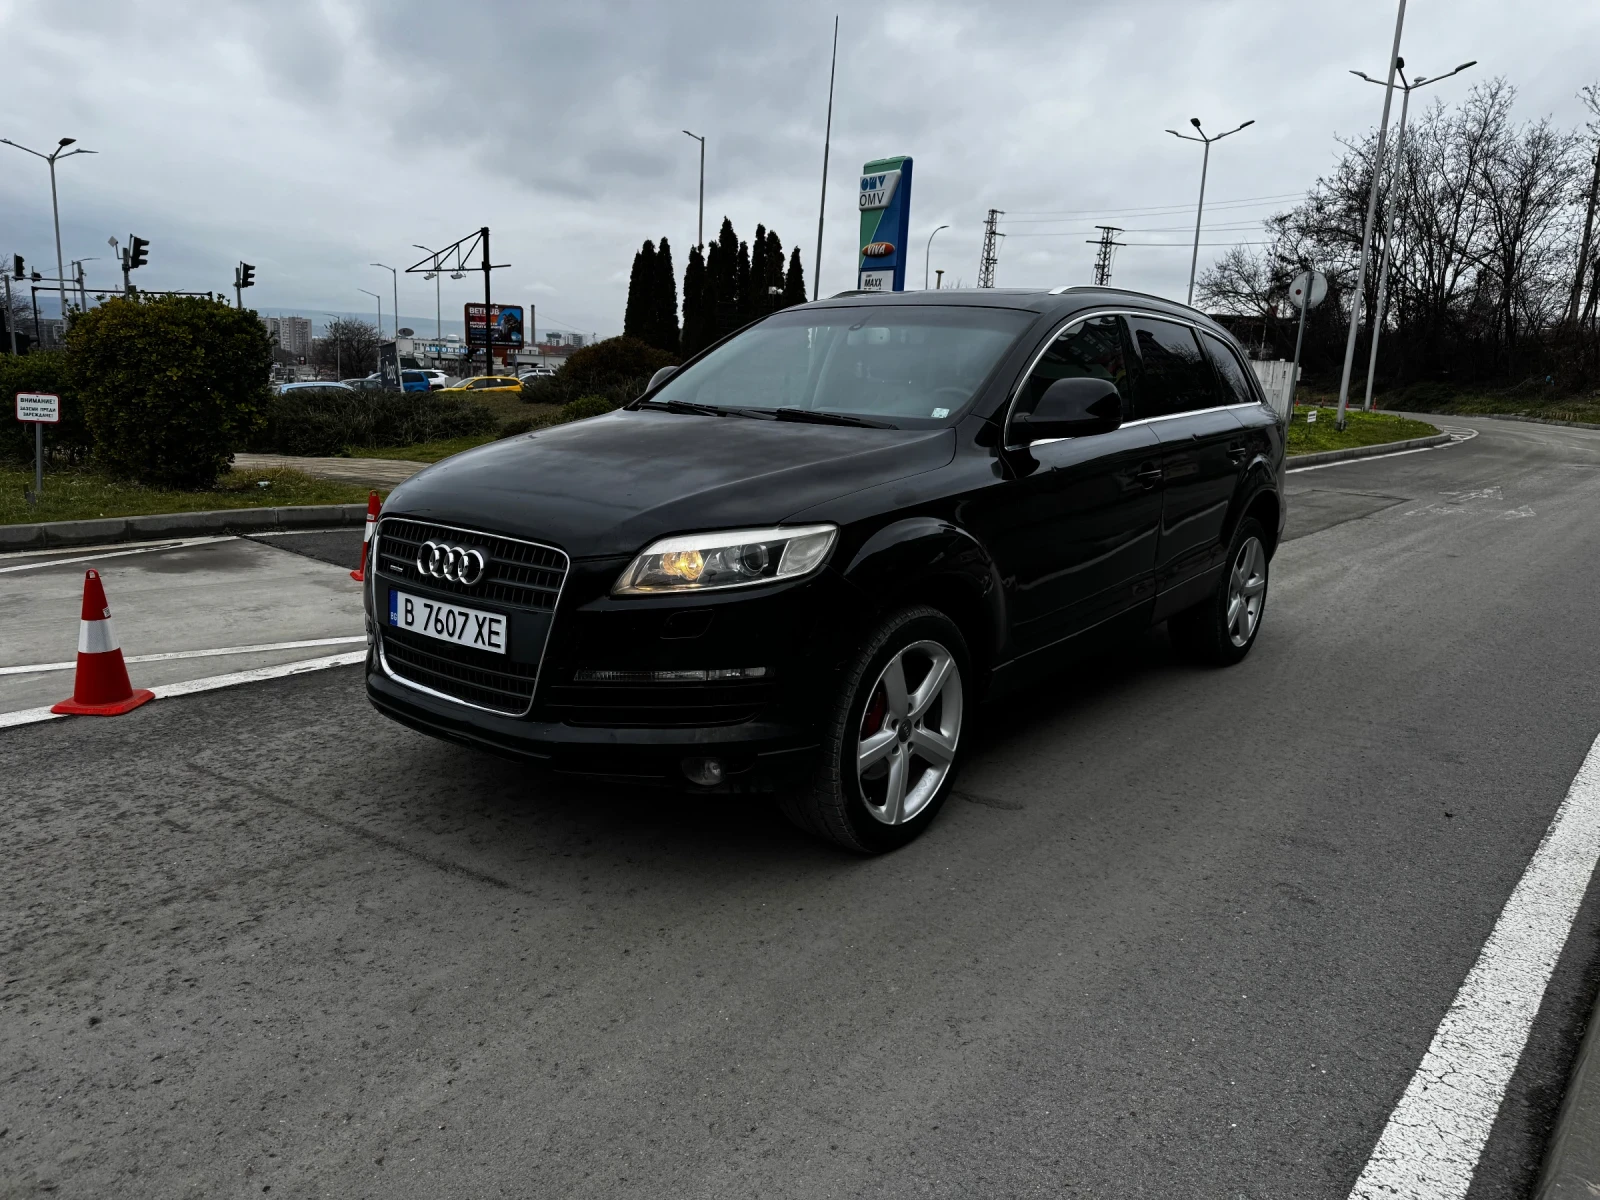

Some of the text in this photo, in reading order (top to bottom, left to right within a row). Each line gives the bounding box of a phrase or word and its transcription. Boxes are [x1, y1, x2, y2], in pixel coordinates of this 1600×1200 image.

[860, 192, 885, 206] OMV
[867, 244, 886, 255] VIVA
[864, 278, 882, 287] MAXX
[20, 397, 56, 405] ВНИМАНИЕ!
[390, 611, 398, 621] BG
[404, 597, 502, 649] B 7607 XE
